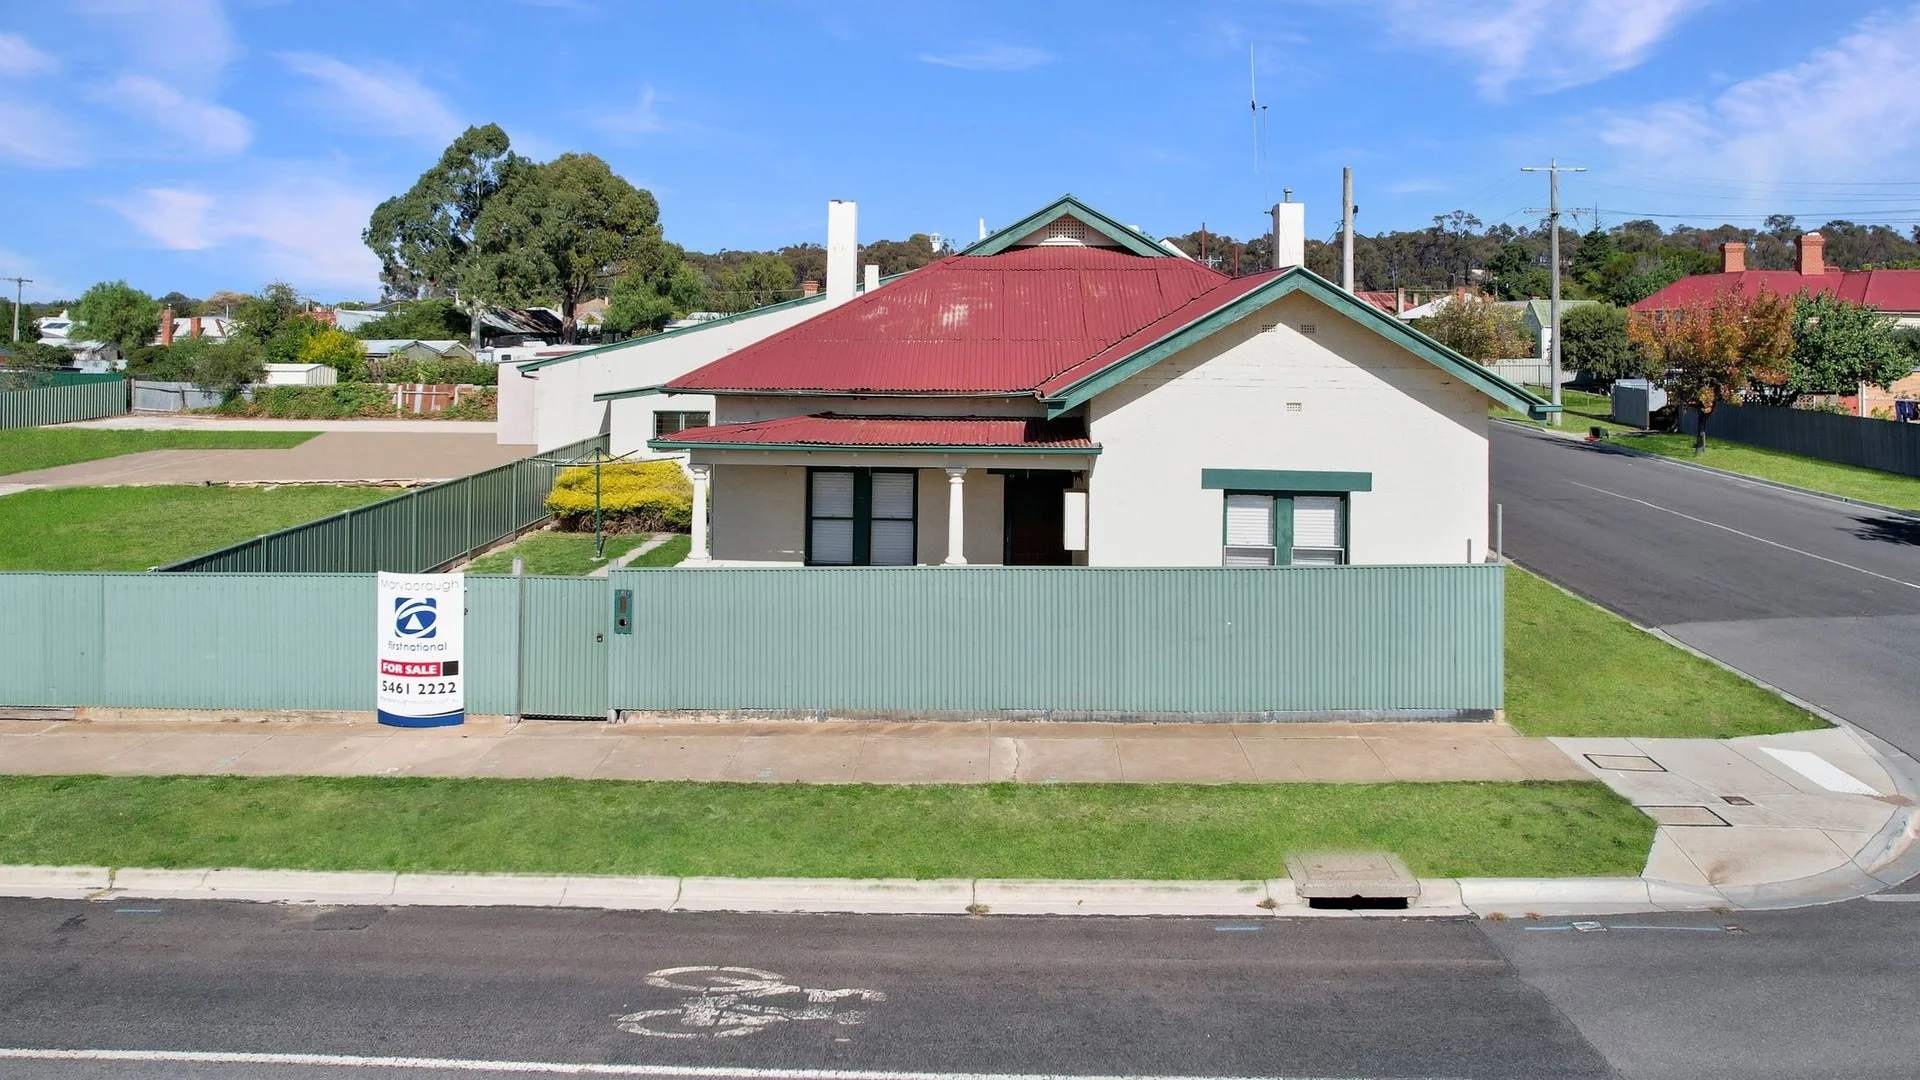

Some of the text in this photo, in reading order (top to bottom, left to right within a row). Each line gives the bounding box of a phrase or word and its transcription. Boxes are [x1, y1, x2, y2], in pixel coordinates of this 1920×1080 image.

[380, 579, 459, 593] Maryborough
[382, 662, 438, 675] FOR SALE
[382, 680, 457, 695] 5461 2222
